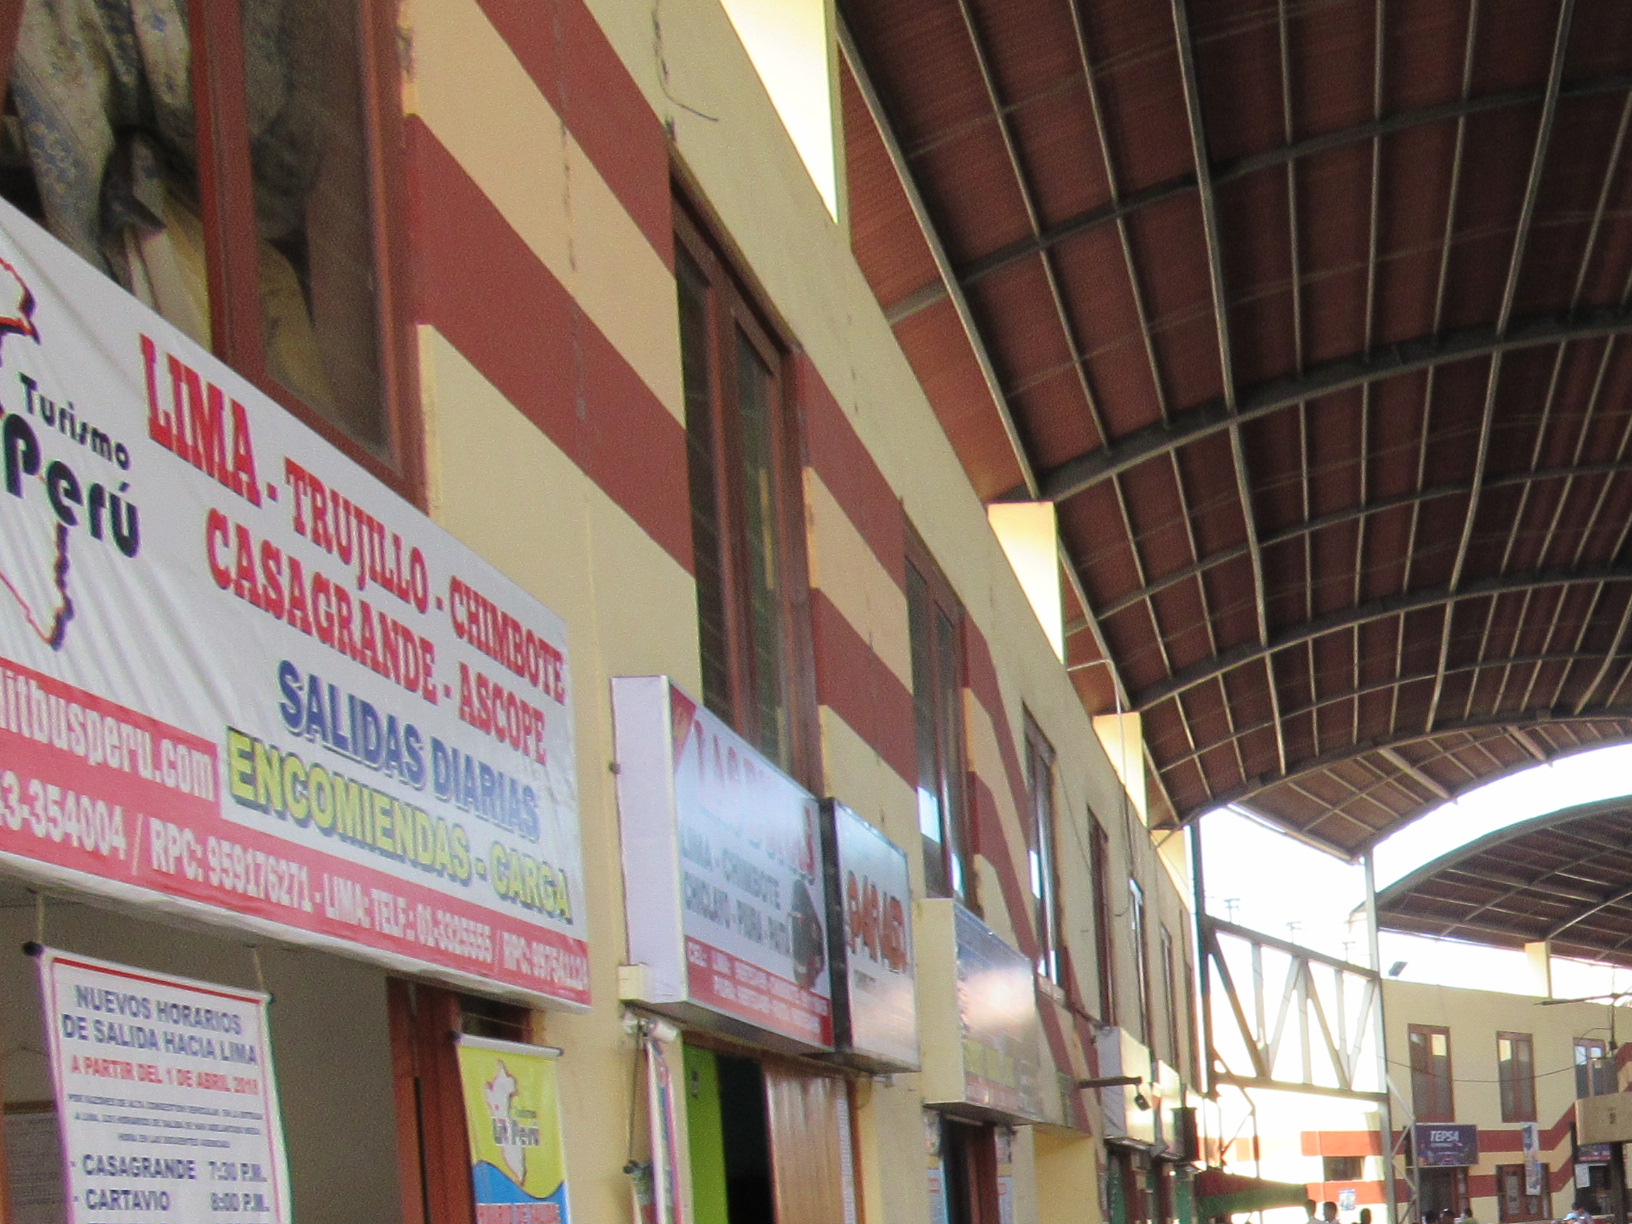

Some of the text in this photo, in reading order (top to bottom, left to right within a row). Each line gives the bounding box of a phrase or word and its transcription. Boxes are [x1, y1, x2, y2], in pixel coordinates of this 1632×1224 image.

[17, 370, 132, 472] Turismo
[139, 332, 263, 508] LIMA
[284, 455, 431, 616] TRUJILLO
[449, 573, 567, 705] CHIMBOTE
[206, 507, 438, 707] CASAGRANDE
[458, 660, 547, 766] ASCOPE
[277, 658, 427, 786] SALIDAS
[430, 735, 541, 844] DIARIAS
[149, 816, 203, 879] RPC:
[227, 727, 472, 887] ENCOMIENDAS
[489, 842, 574, 926] CARGA
[61, 1013, 258, 1065] DE SALIDA HACIA LIMA
[75, 985, 243, 1036] NUEVOS HORARIOS
[71, 1055, 83, 1074] A
[84, 1056, 136, 1081] PARTIR
[137, 1063, 164, 1084] DEL
[176, 1068, 195, 1088] DE
[1429, 1130, 1460, 1142] TEPSA
[82, 1154, 196, 1180] CASAGRANDE
[85, 1189, 170, 1211] CARTAVIO
